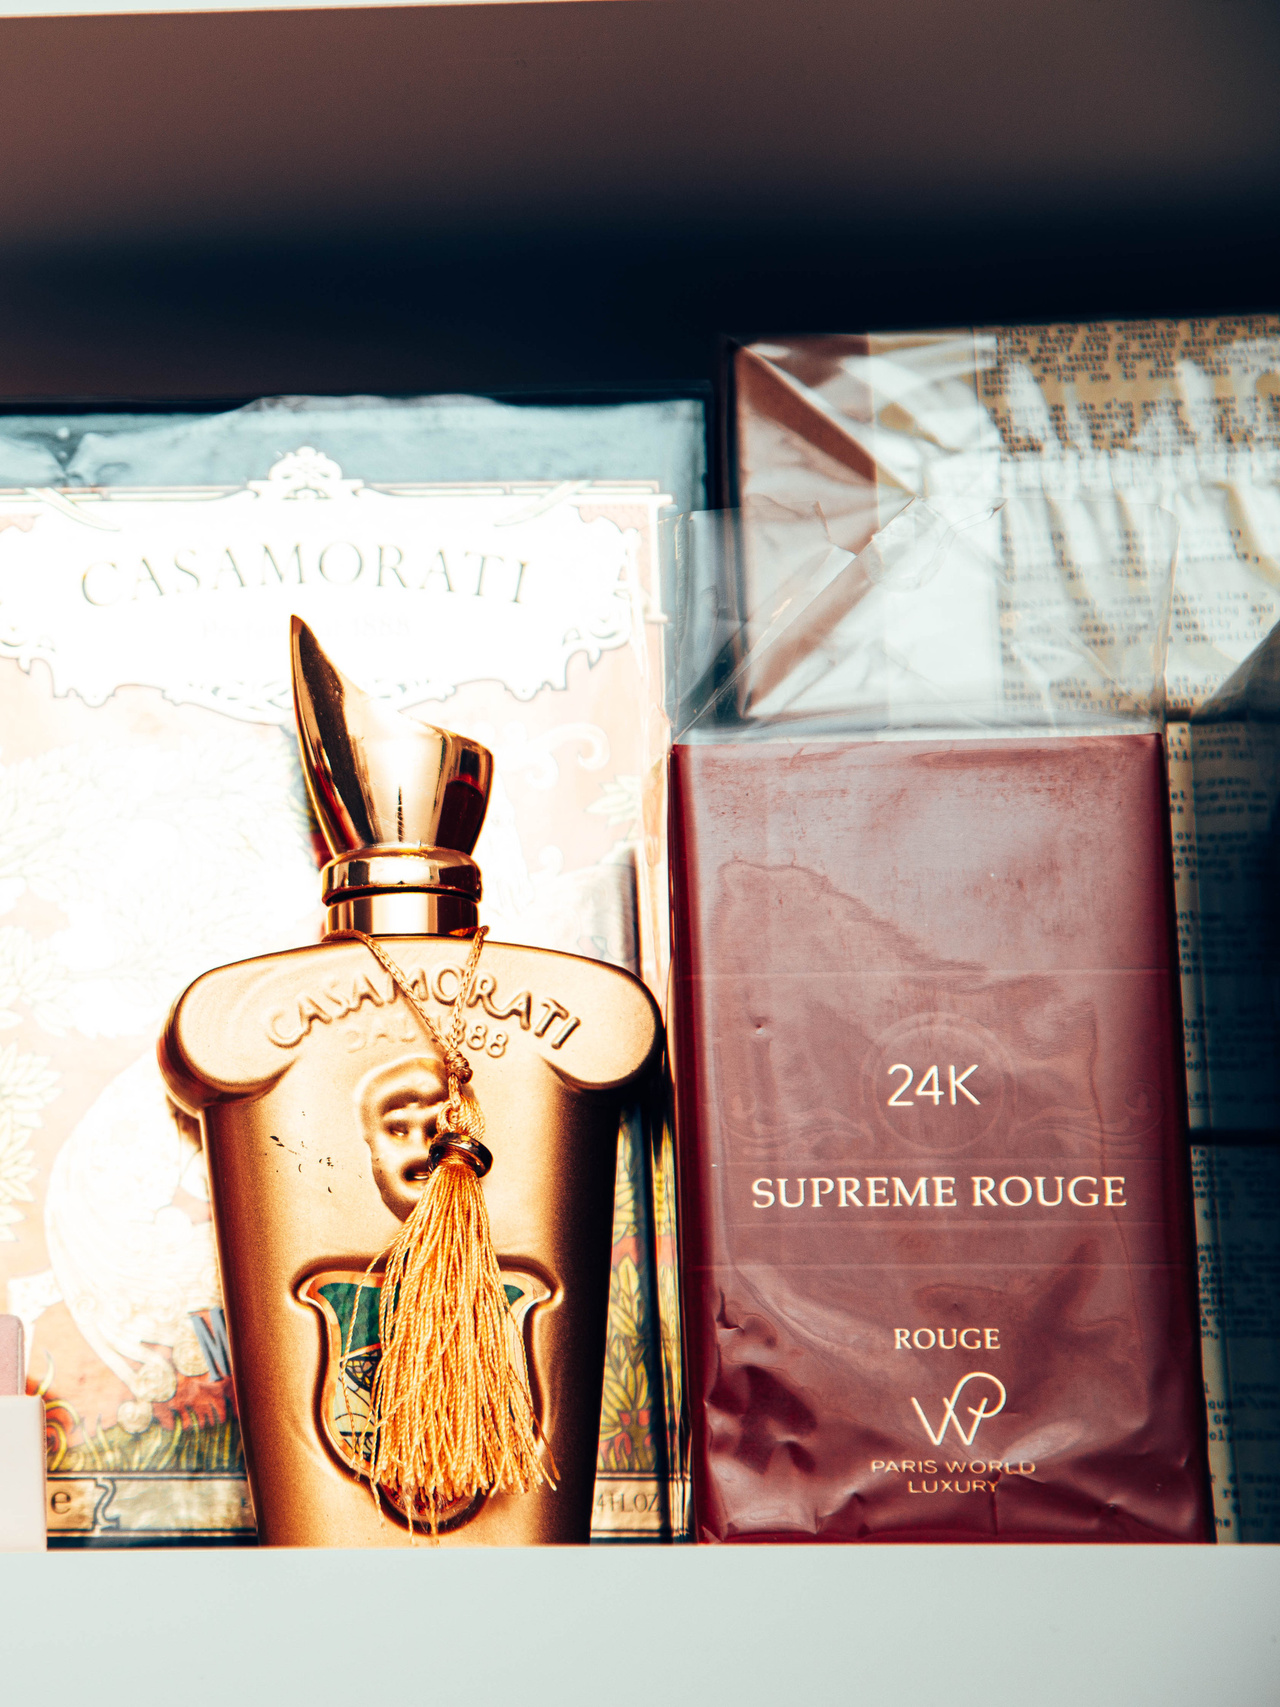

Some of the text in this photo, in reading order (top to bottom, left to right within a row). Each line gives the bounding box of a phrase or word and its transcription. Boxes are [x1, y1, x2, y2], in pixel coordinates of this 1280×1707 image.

[81, 541, 528, 606] CASAMORATI
[266, 965, 582, 1051] CASAMORATI
[887, 1063, 982, 1106] 24K
[752, 1175, 1128, 1209] SUPREME ROUGE
[893, 1327, 1002, 1350] ROUGE
[871, 1459, 1037, 1475] PARIS WORLD
[908, 1479, 1001, 1494] LUXURY
